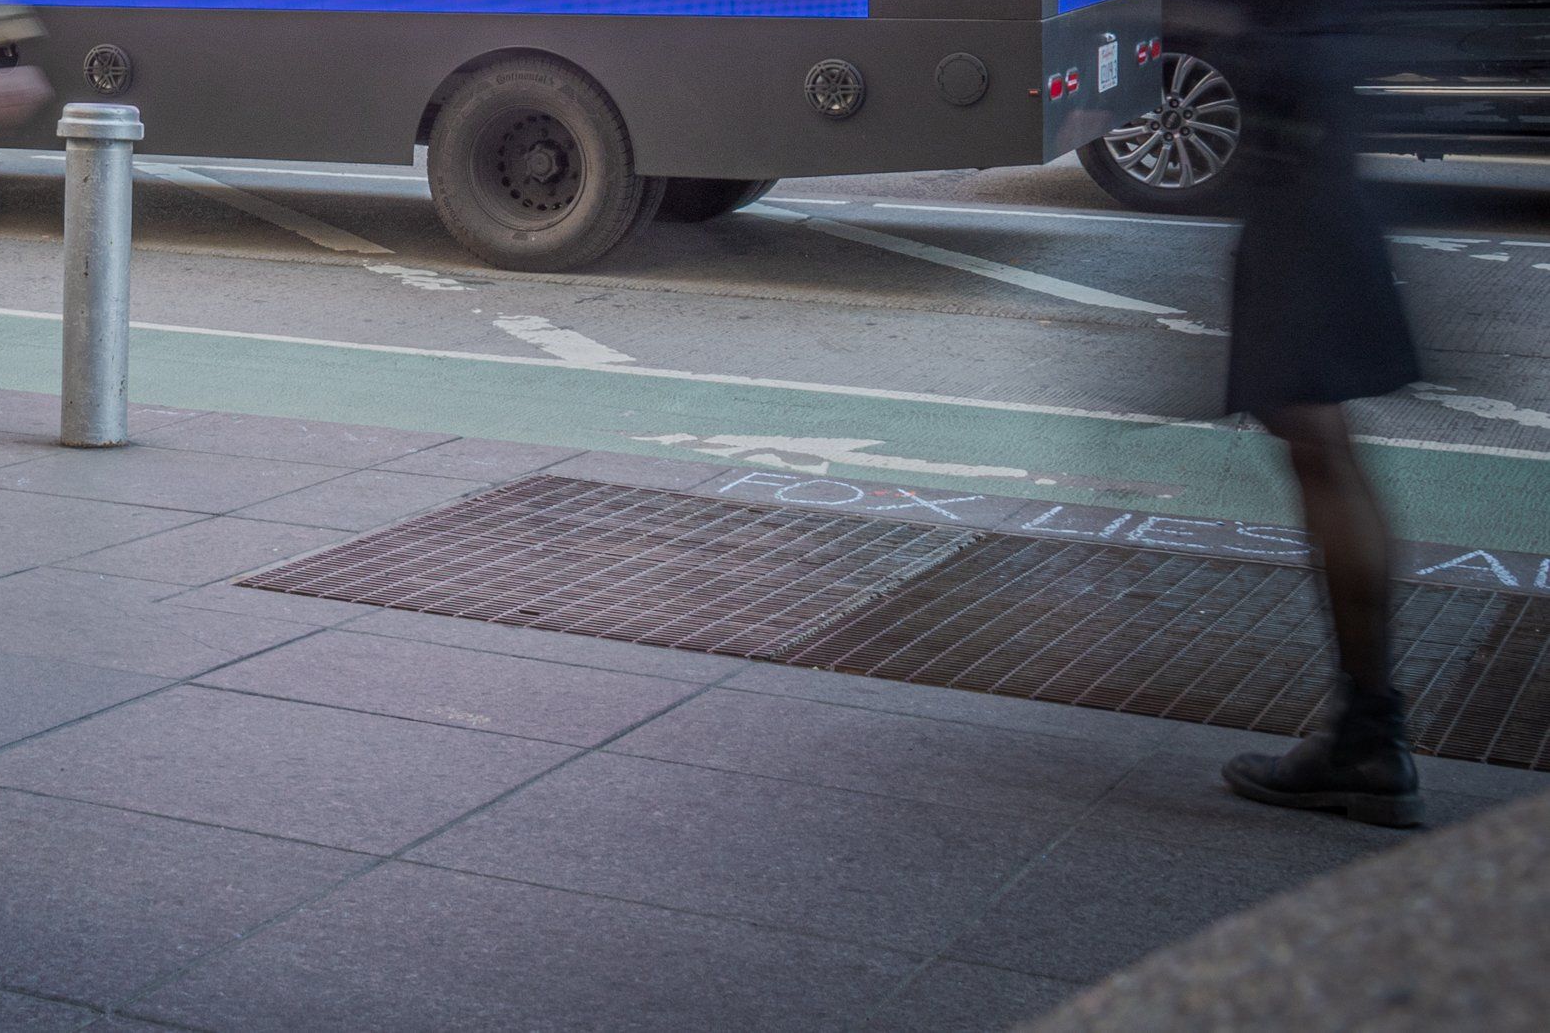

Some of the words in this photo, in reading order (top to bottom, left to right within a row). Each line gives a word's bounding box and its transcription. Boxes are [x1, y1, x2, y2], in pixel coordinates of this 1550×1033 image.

[716, 470, 985, 521] FOX
[1021, 505, 1313, 555] LIES
[1415, 549, 1550, 589] A
